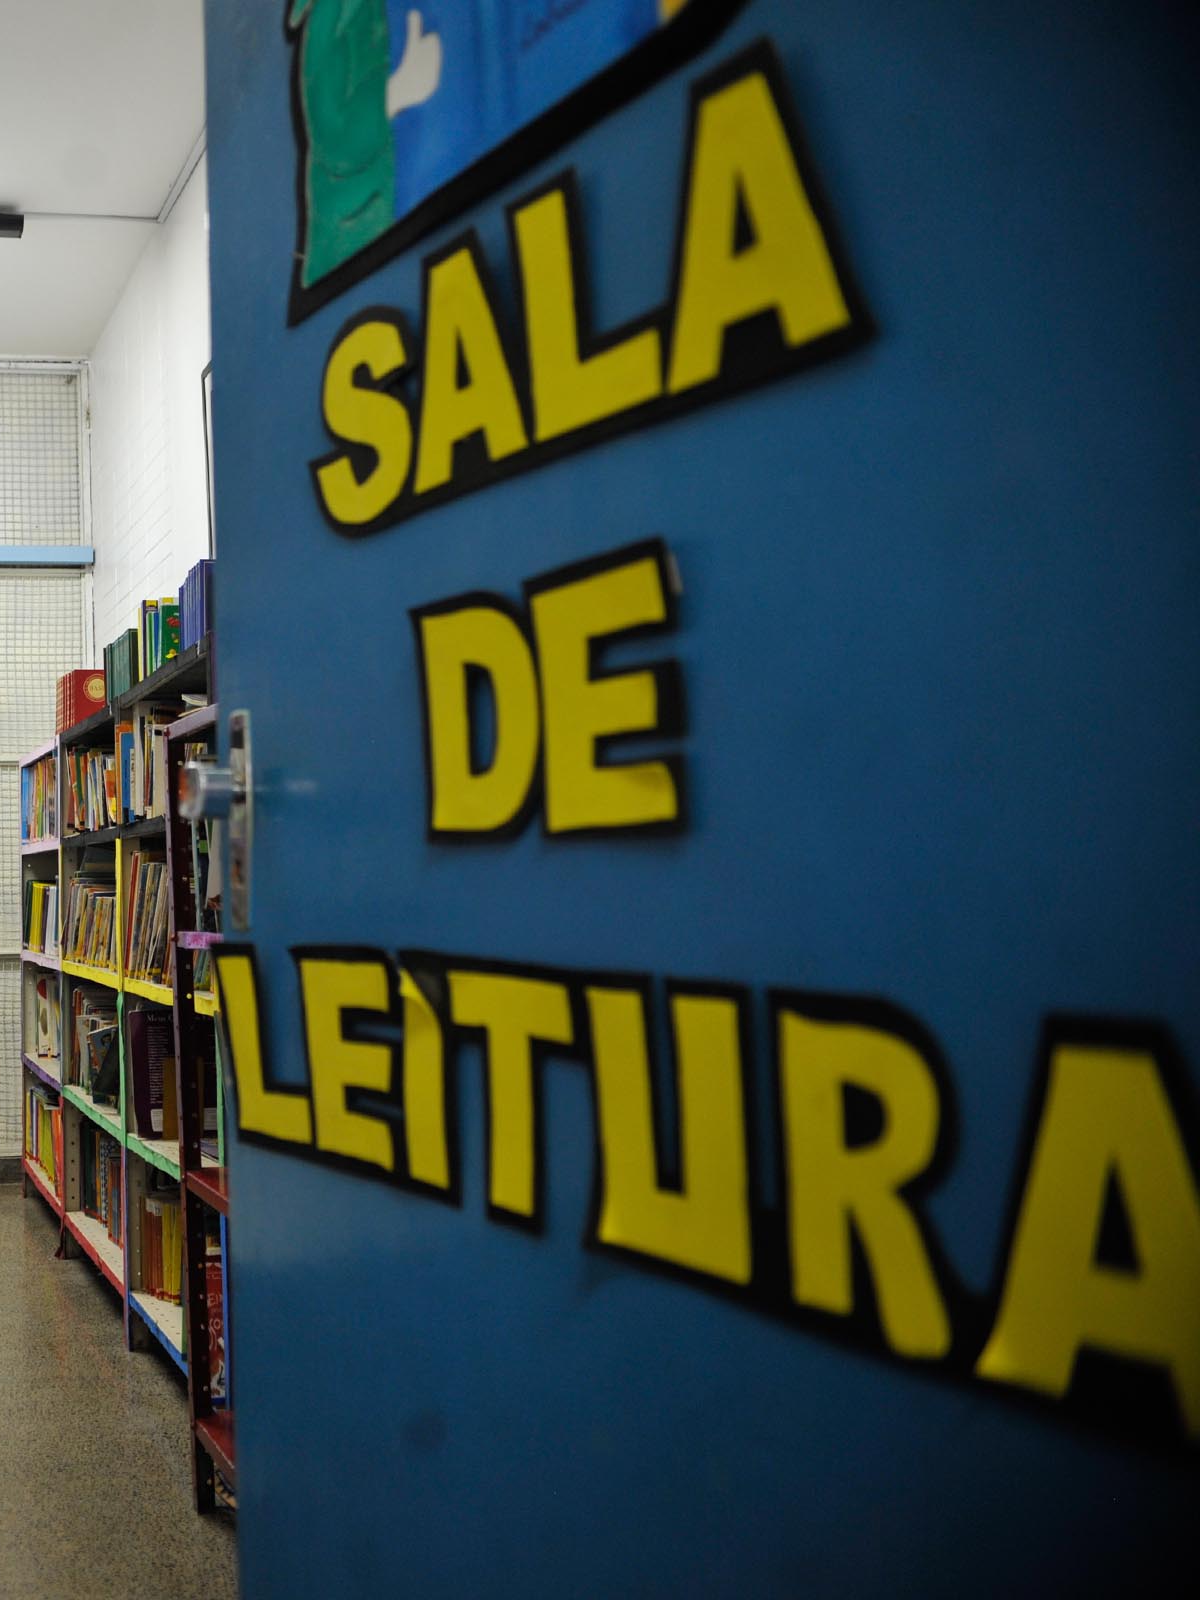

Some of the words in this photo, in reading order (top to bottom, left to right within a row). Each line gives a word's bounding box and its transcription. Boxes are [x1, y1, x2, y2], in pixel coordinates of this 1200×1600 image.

[315, 70, 853, 527] SALA
[420, 556, 680, 835] DE
[214, 954, 1200, 1442] LEITURA
